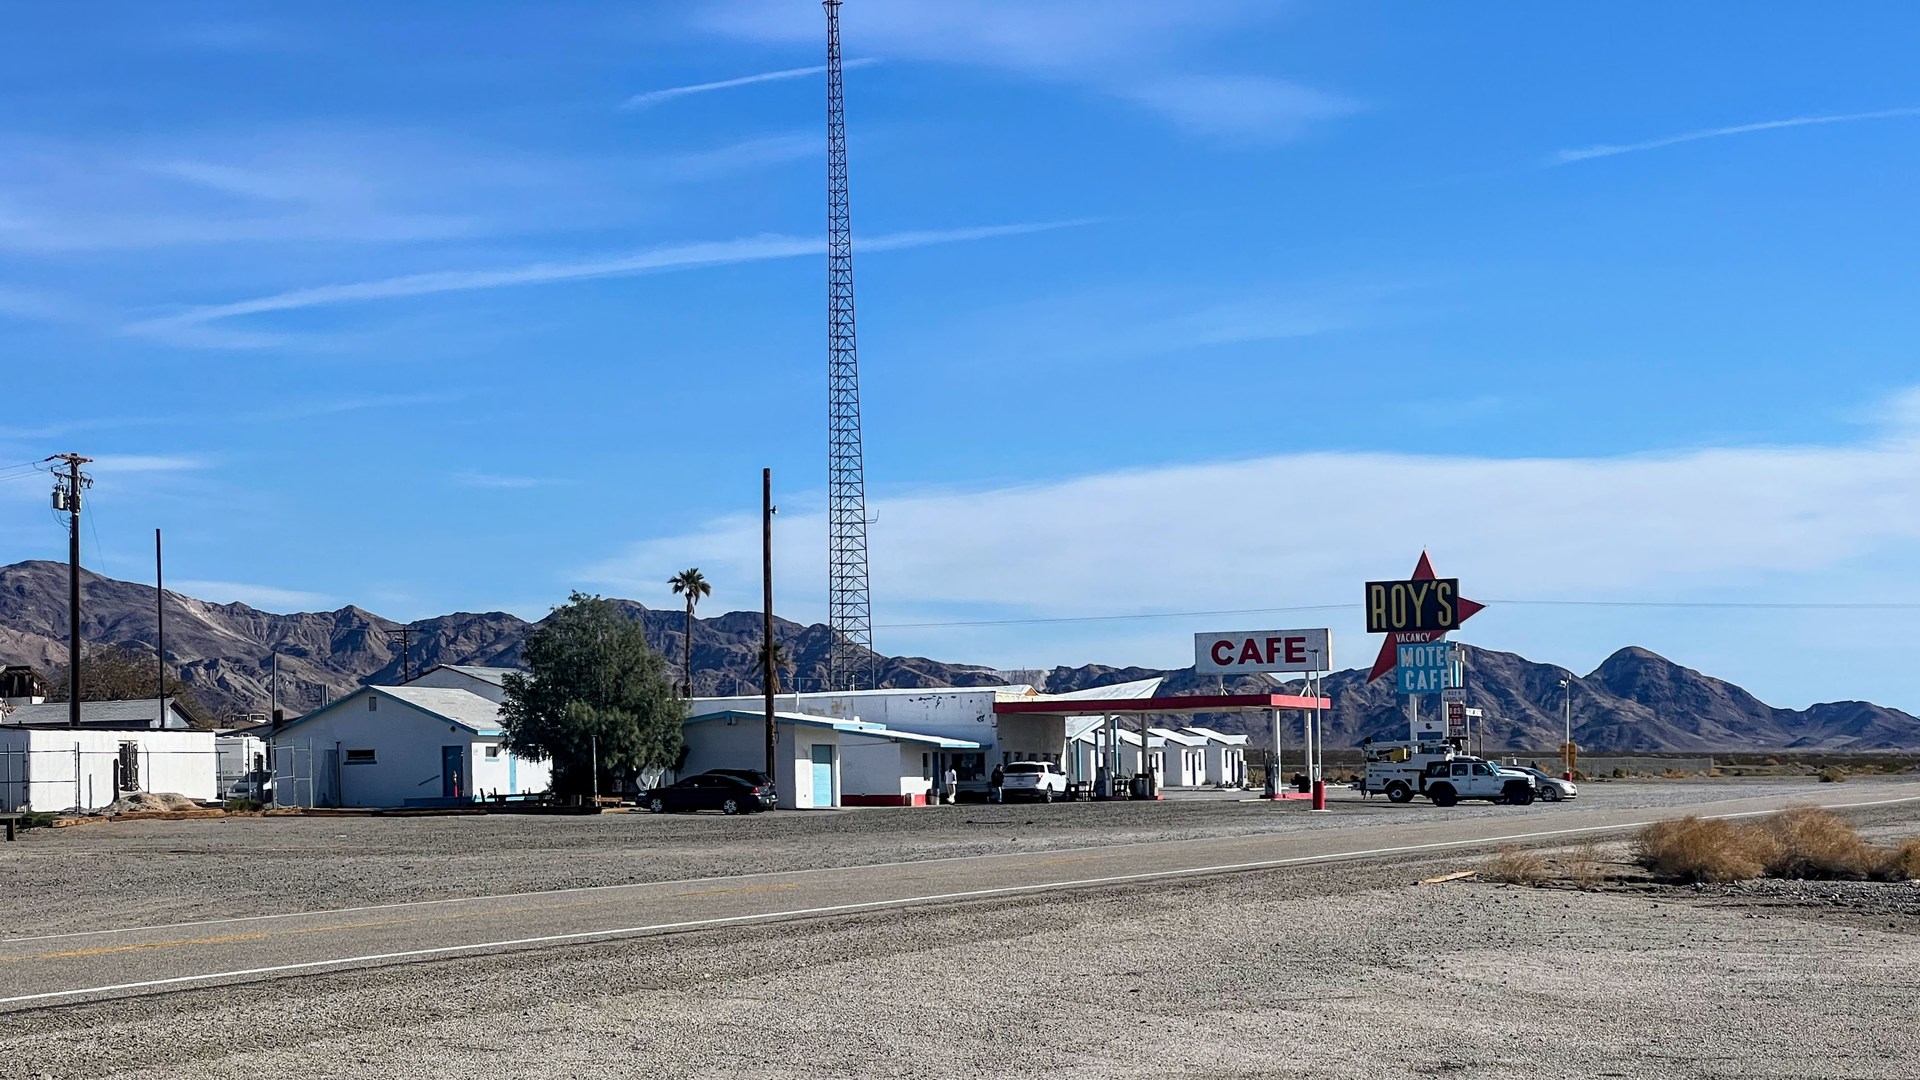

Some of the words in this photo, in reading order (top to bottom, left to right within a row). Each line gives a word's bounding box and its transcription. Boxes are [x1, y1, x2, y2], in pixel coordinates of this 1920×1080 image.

[1371, 581, 1452, 629] ROY'S
[1395, 632, 1431, 643] VACANCY
[1211, 637, 1307, 666] CAFE
[1405, 669, 1450, 690] CAFE
